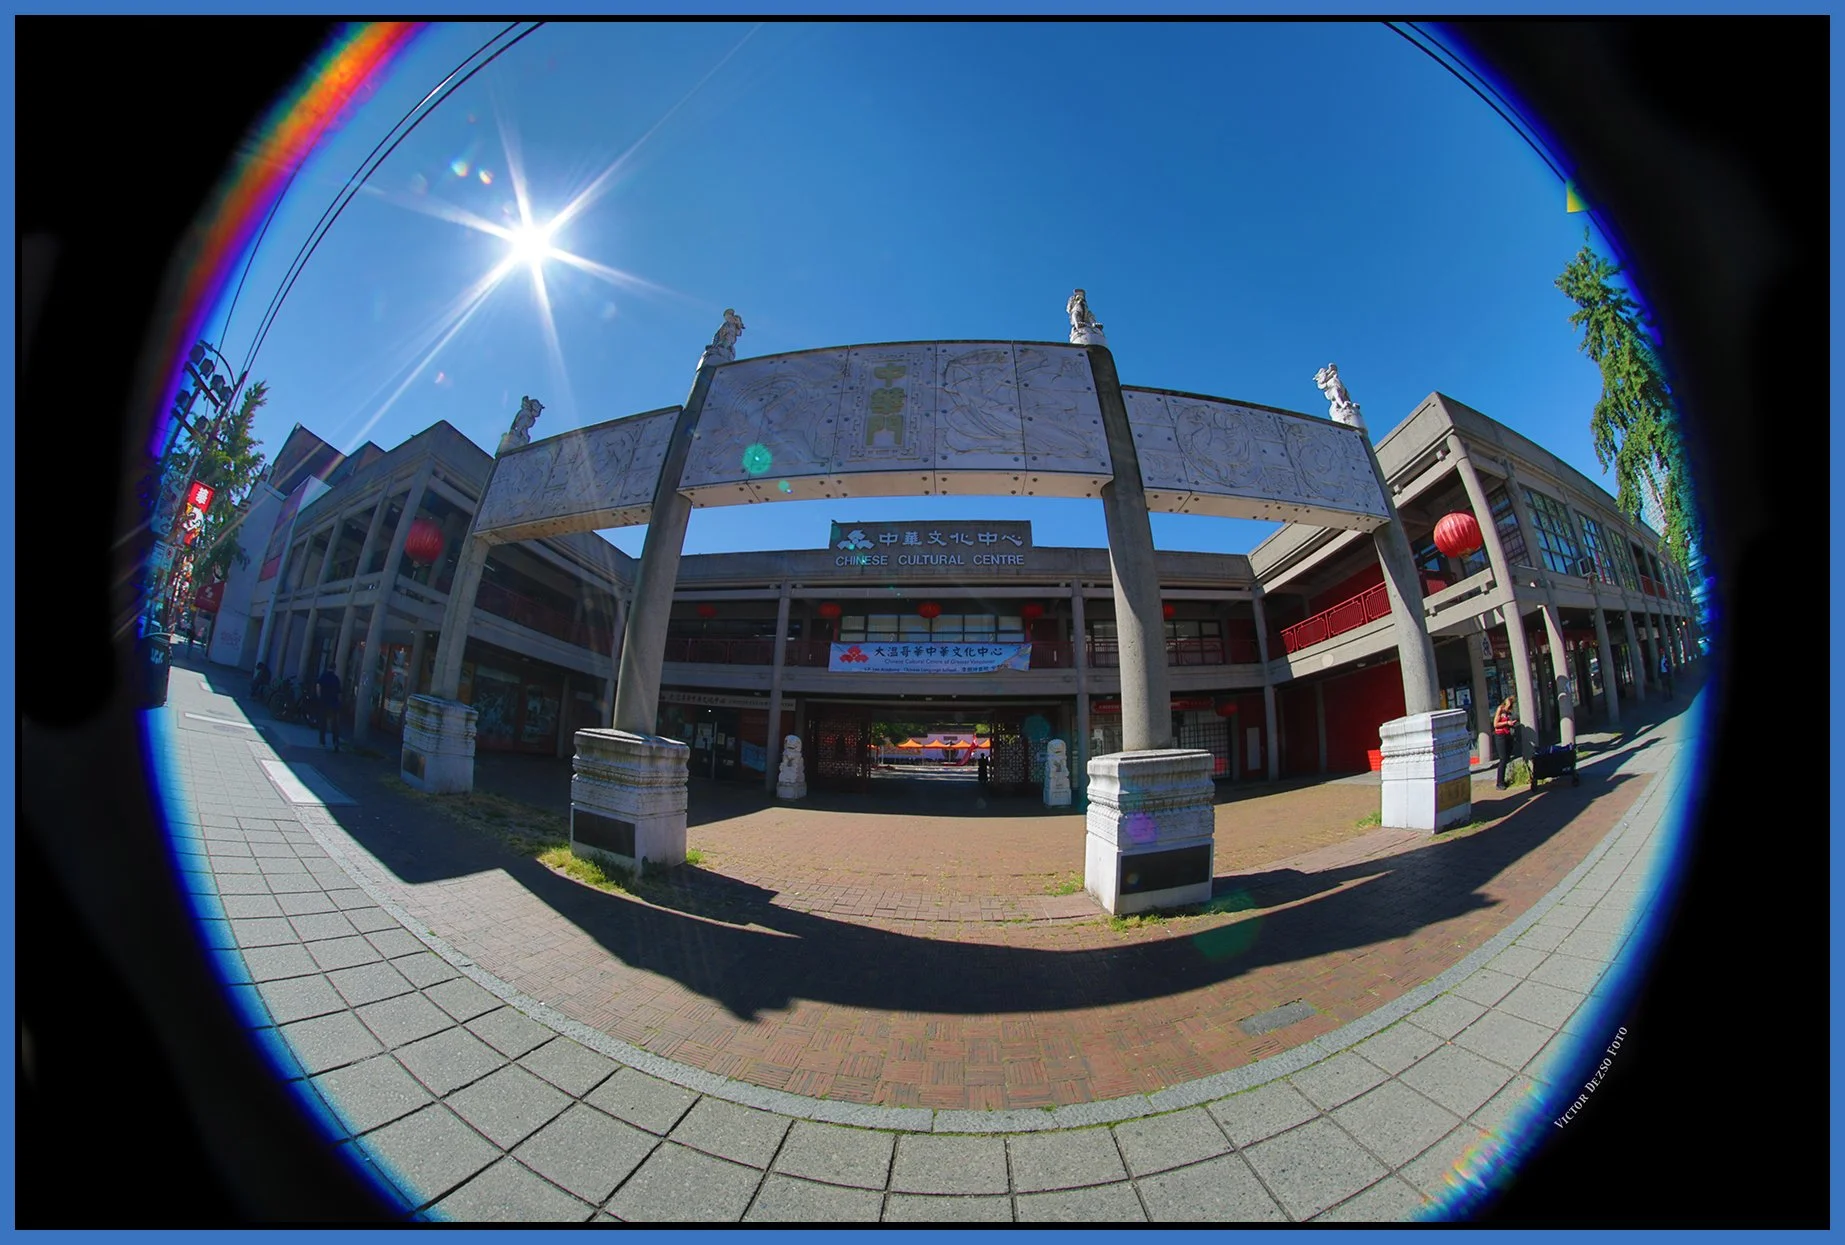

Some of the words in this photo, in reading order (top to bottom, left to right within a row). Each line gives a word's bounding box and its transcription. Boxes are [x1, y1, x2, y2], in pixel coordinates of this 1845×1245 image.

[878, 530, 1025, 547] 中華文化中心
[835, 555, 889, 566] CHINESE
[898, 554, 965, 566] CULTURAL
[973, 554, 1025, 566] CENTRE
